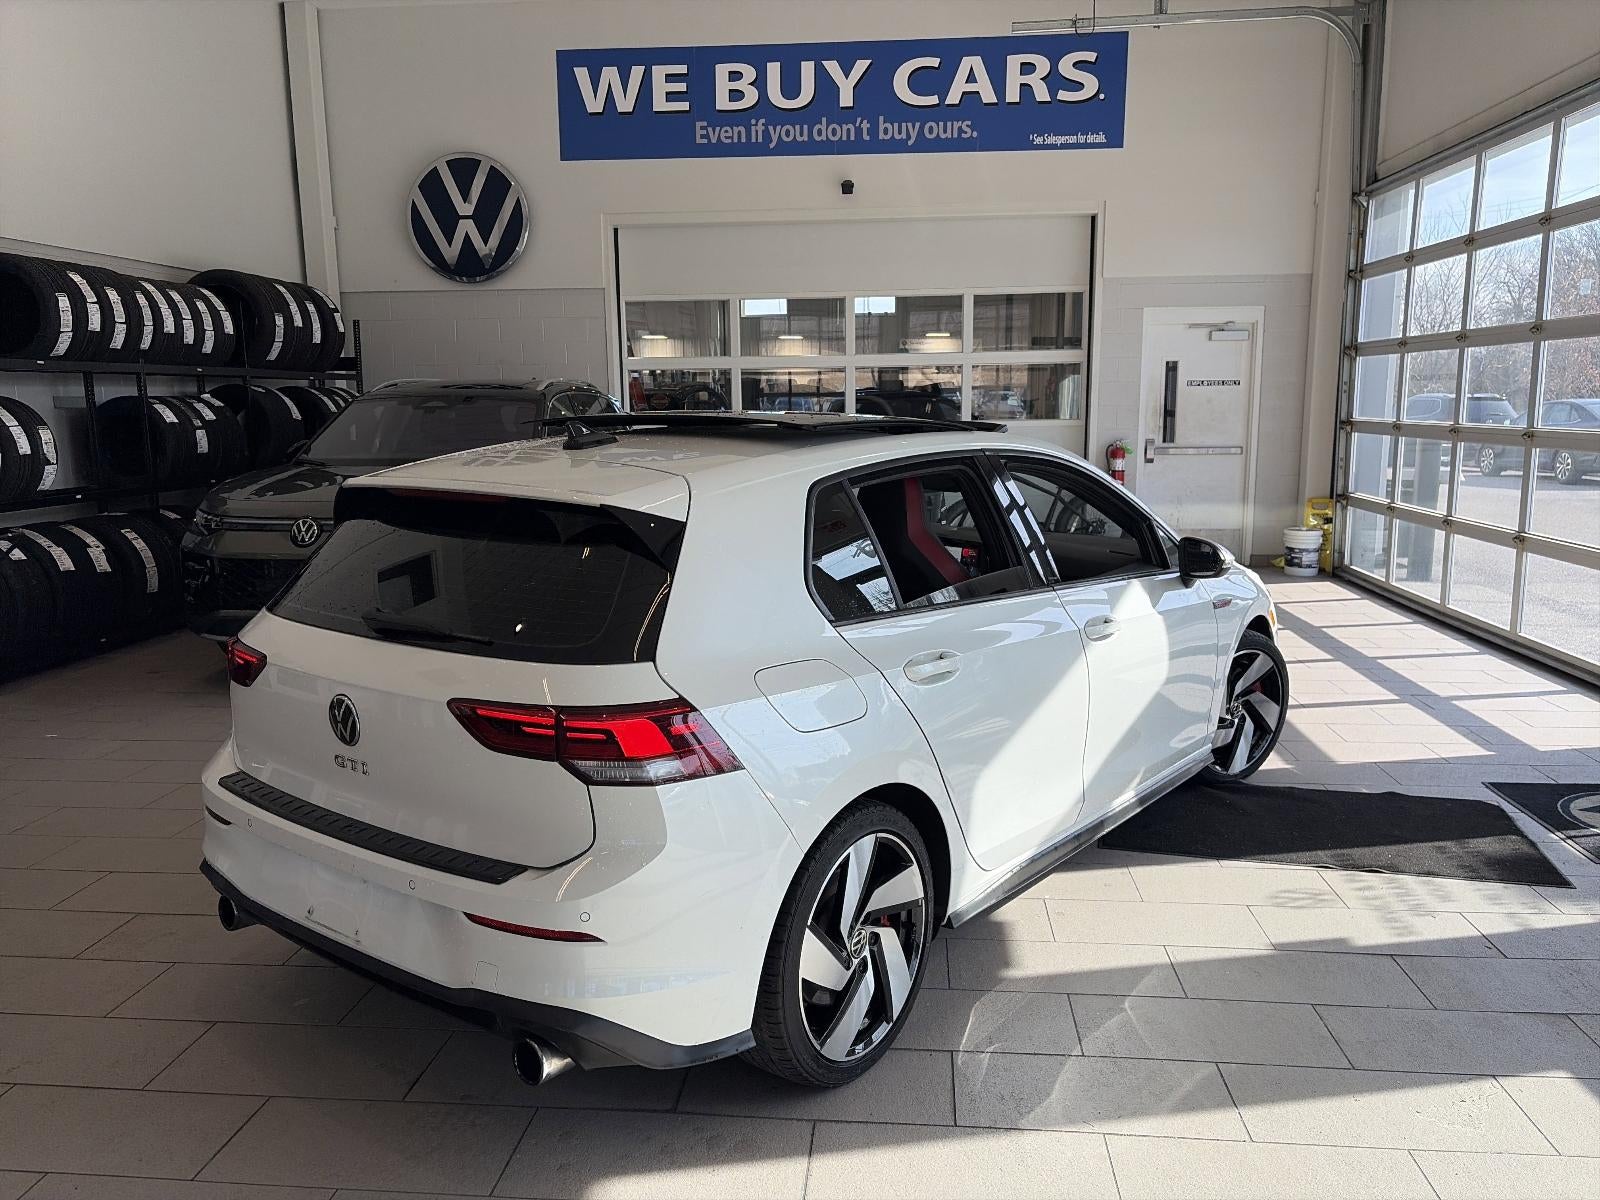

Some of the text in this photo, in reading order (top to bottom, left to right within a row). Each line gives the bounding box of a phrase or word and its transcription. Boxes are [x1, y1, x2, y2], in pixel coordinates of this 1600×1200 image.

[573, 51, 1105, 114] WE BUY CARS.
[695, 121, 746, 144] Even
[750, 118, 766, 143] if
[768, 124, 809, 149] you
[878, 115, 920, 146] buy
[923, 120, 978, 139] ours.
[1044, 132, 1077, 147] Salesperson
[1077, 131, 1087, 143] for
[1087, 131, 1107, 143] details.
[334, 754, 369, 776] GTI
